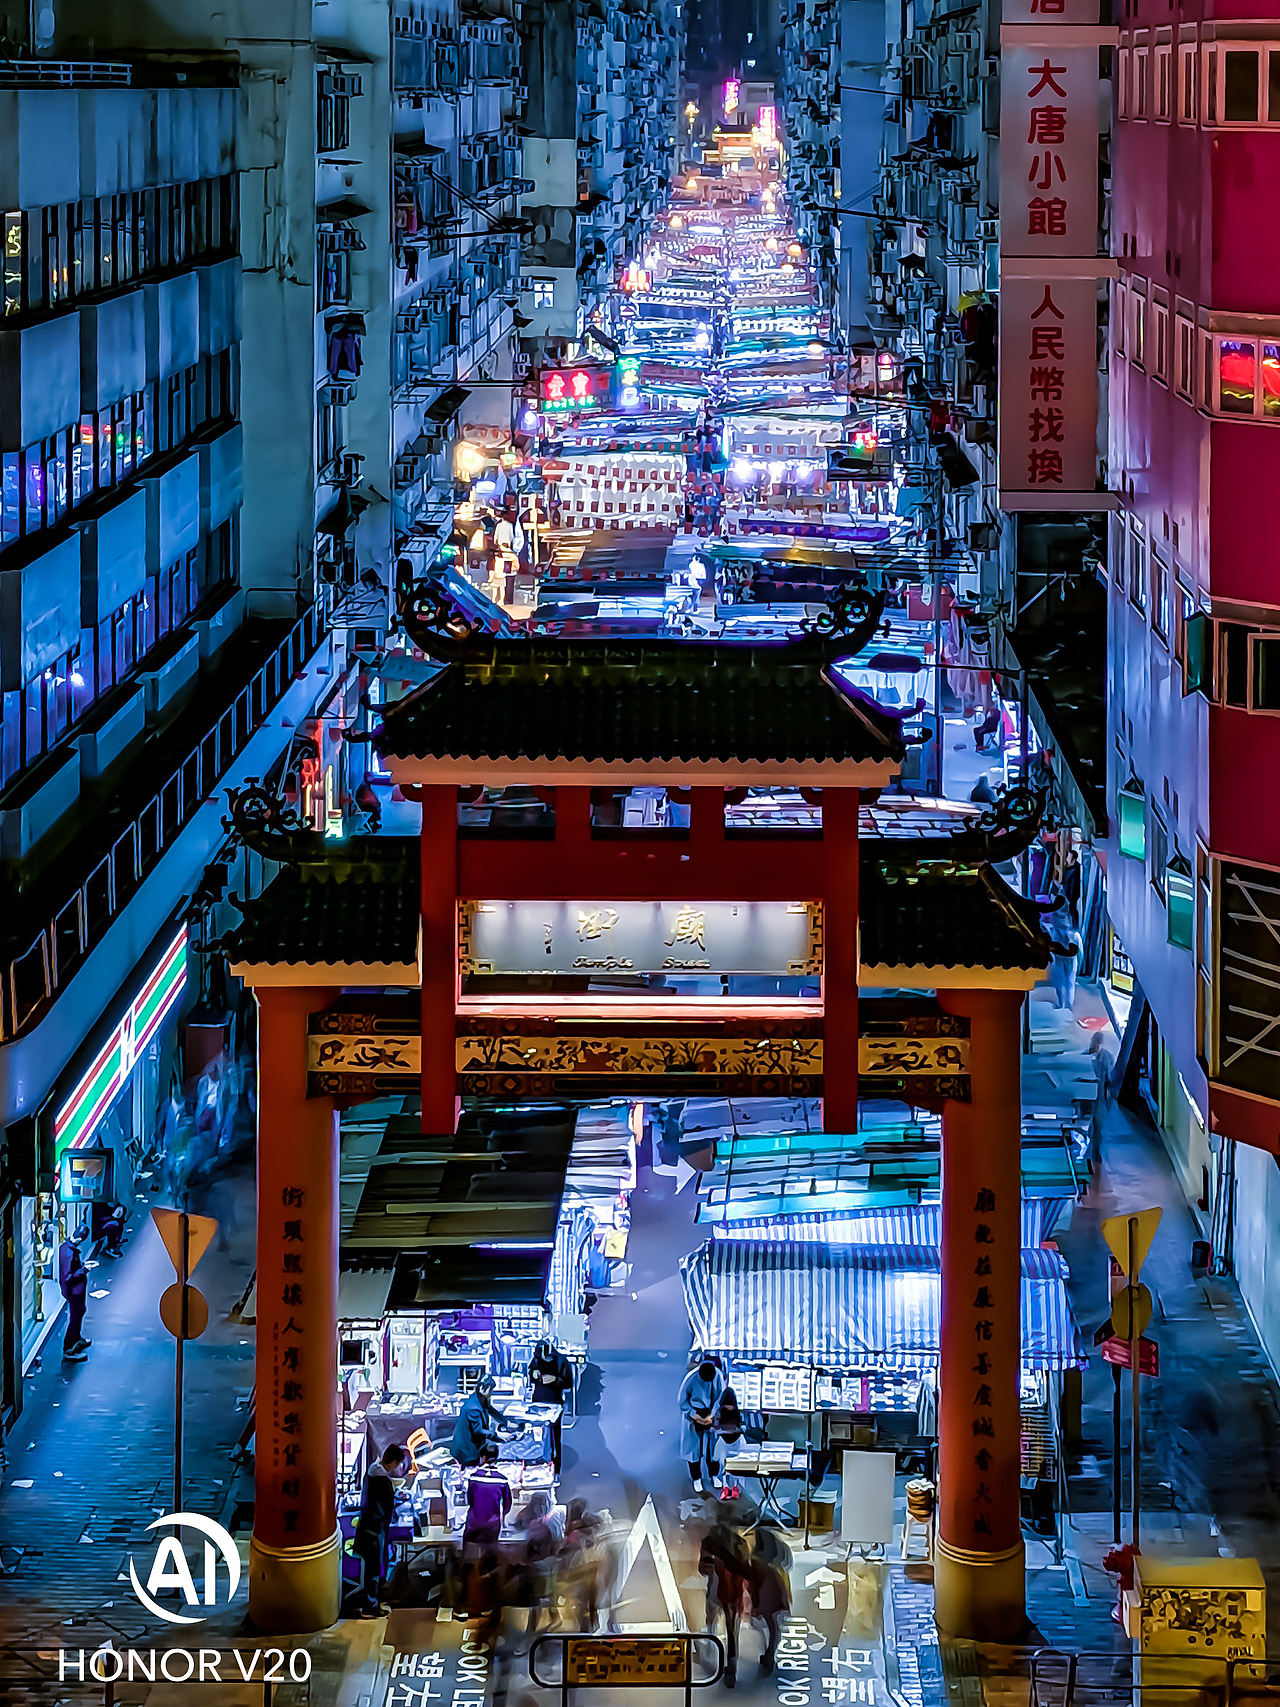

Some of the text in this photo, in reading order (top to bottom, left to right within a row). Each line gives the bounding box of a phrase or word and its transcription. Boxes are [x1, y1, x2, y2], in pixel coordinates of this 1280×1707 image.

[1027, 59, 1067, 236] 大唐小館
[1028, 284, 1066, 485] 人民幣找換
